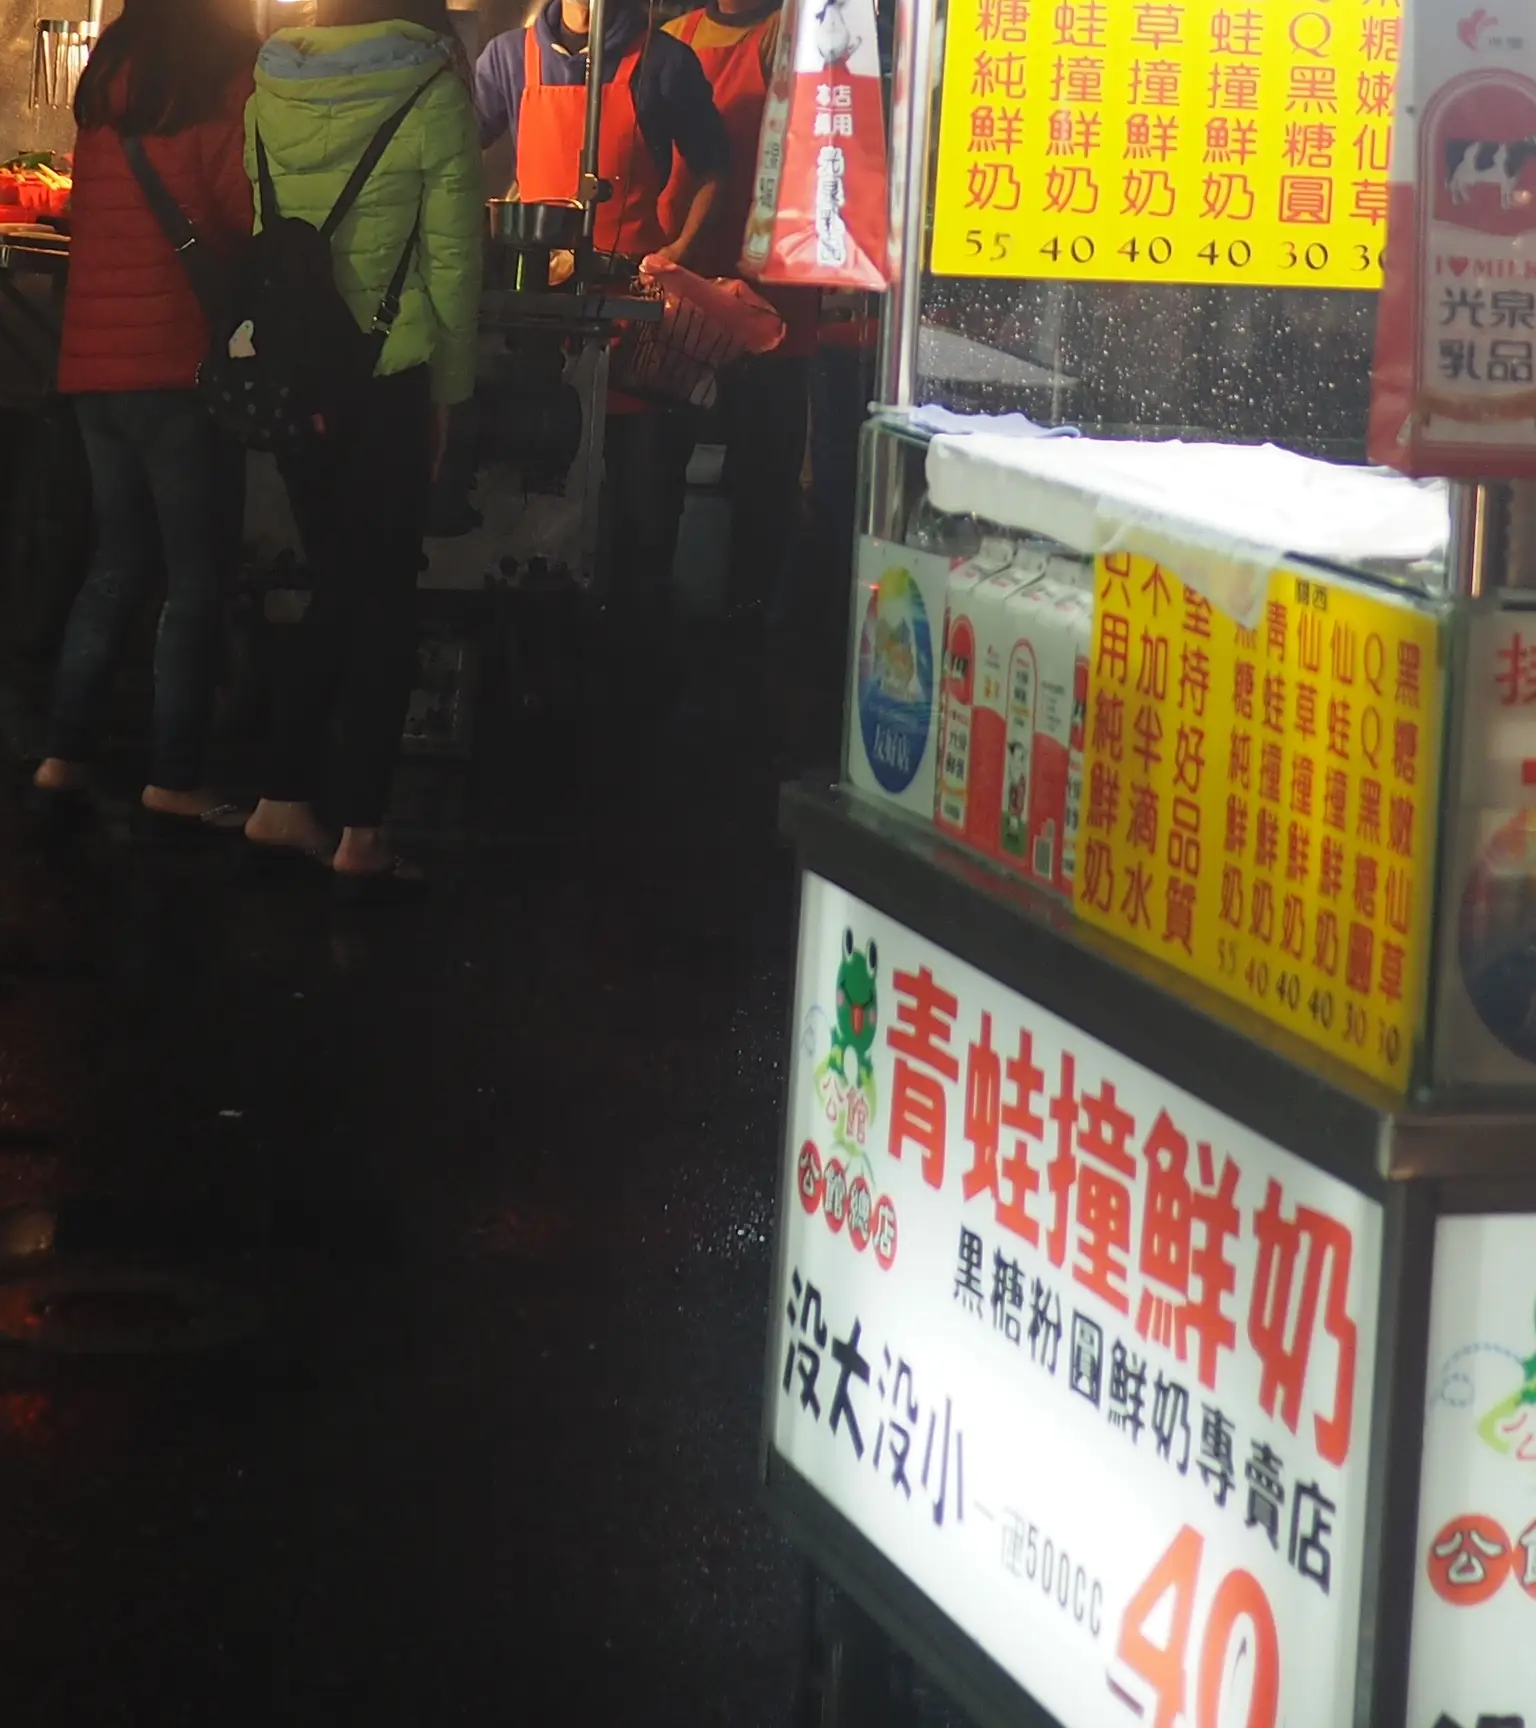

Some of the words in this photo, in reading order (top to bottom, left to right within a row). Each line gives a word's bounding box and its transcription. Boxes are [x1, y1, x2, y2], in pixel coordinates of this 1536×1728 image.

[965, 229, 1012, 262] 55
[1039, 235, 1096, 264] 40
[1116, 235, 1173, 265] 40
[1196, 239, 1252, 268] 40
[1281, 241, 1330, 271] 30
[1438, 287, 1536, 329] 光泉
[1437, 339, 1534, 383] 乳品
[1080, 552, 1132, 915] 只用純鮮奶
[1121, 563, 1173, 931] 不加半滴水
[1249, 600, 1288, 944] 青蛙撞鮮奶
[1281, 610, 1320, 960] 仙草撞鮮奶
[1276, 972, 1302, 1012] 40
[1307, 990, 1334, 1031] 40
[820, 1076, 868, 1144] 公館
[798, 1140, 897, 1270] 公館總店
[886, 963, 1356, 1469] 青蛙撞鮮奶
[954, 1222, 1337, 1597] 黑糖粉圓鮮奶專賣店
[1109, 1522, 1280, 1728] 40
